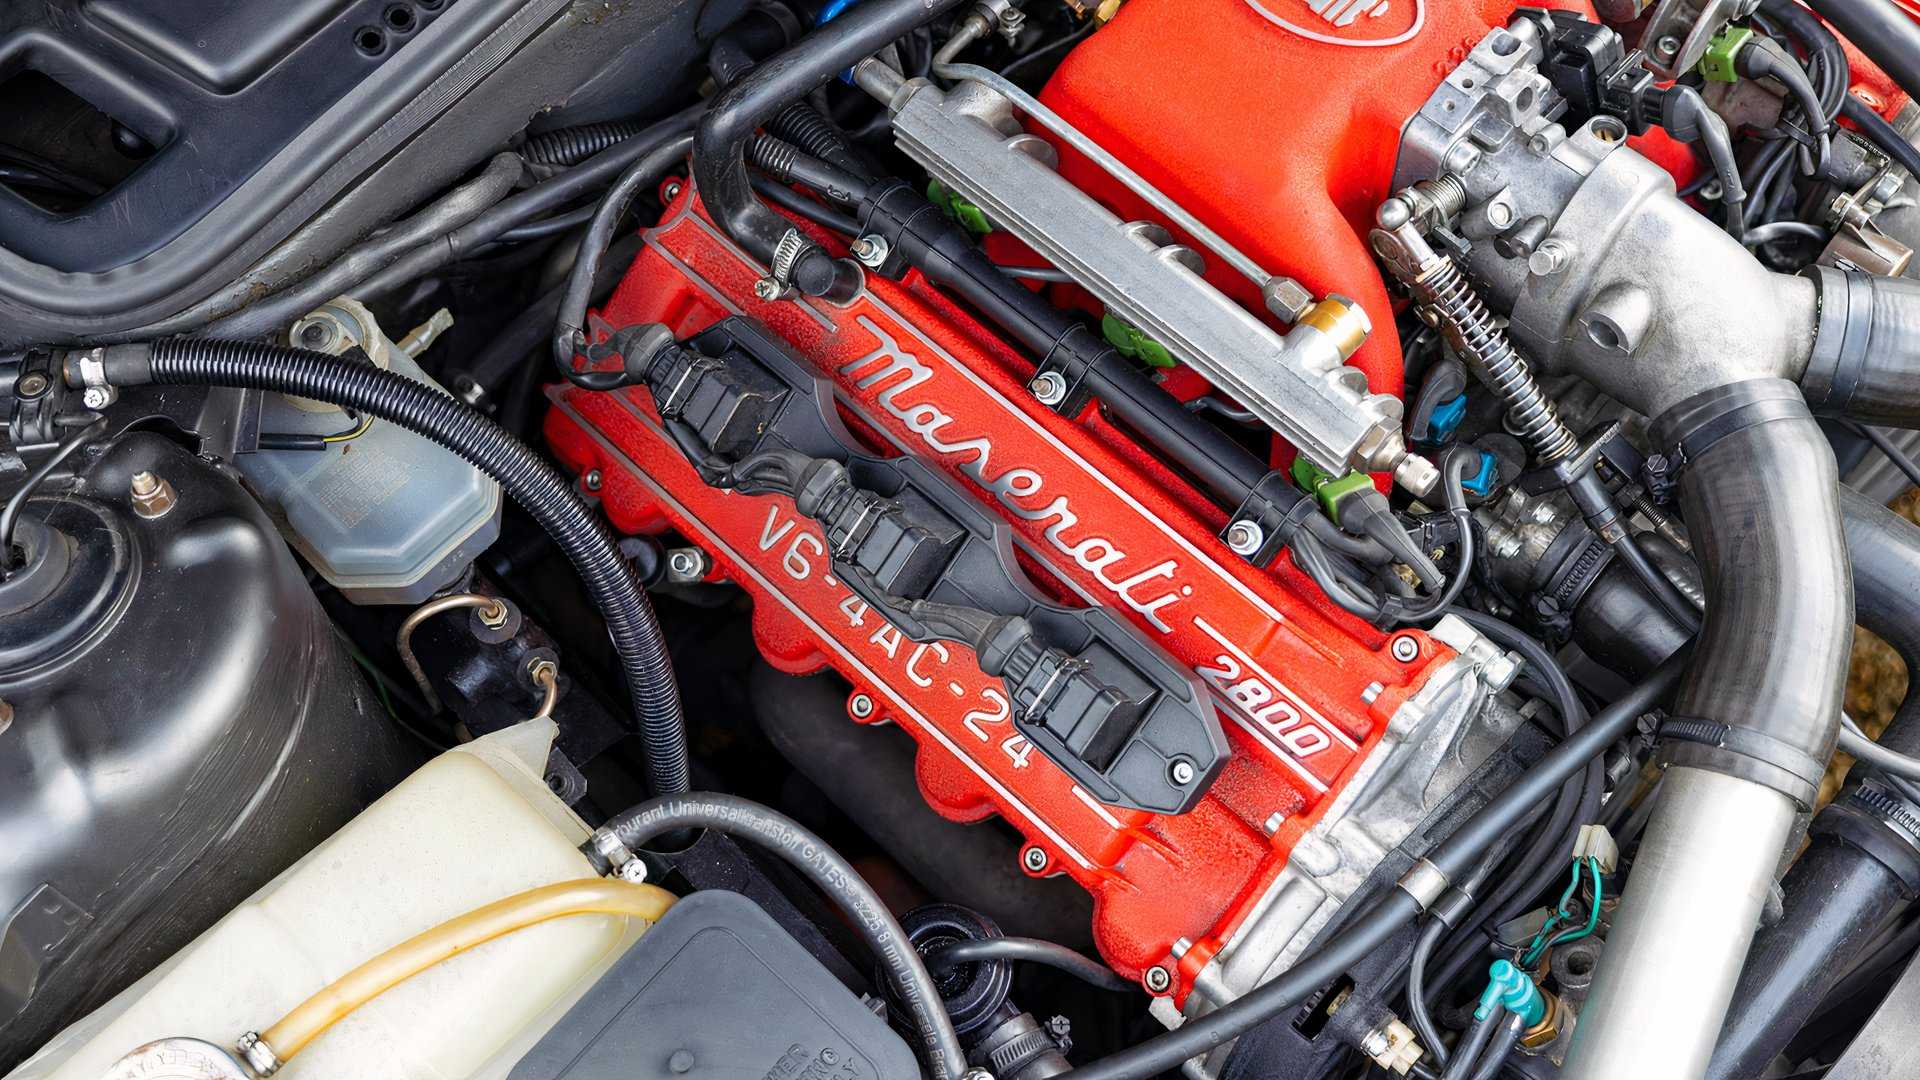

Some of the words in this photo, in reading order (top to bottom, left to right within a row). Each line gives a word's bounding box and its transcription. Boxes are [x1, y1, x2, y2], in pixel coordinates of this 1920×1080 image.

[839, 315, 1193, 633] Maserati
[1195, 654, 1331, 758] 2800
[877, 930, 890, 943] 8
[883, 943, 904, 970] mm
